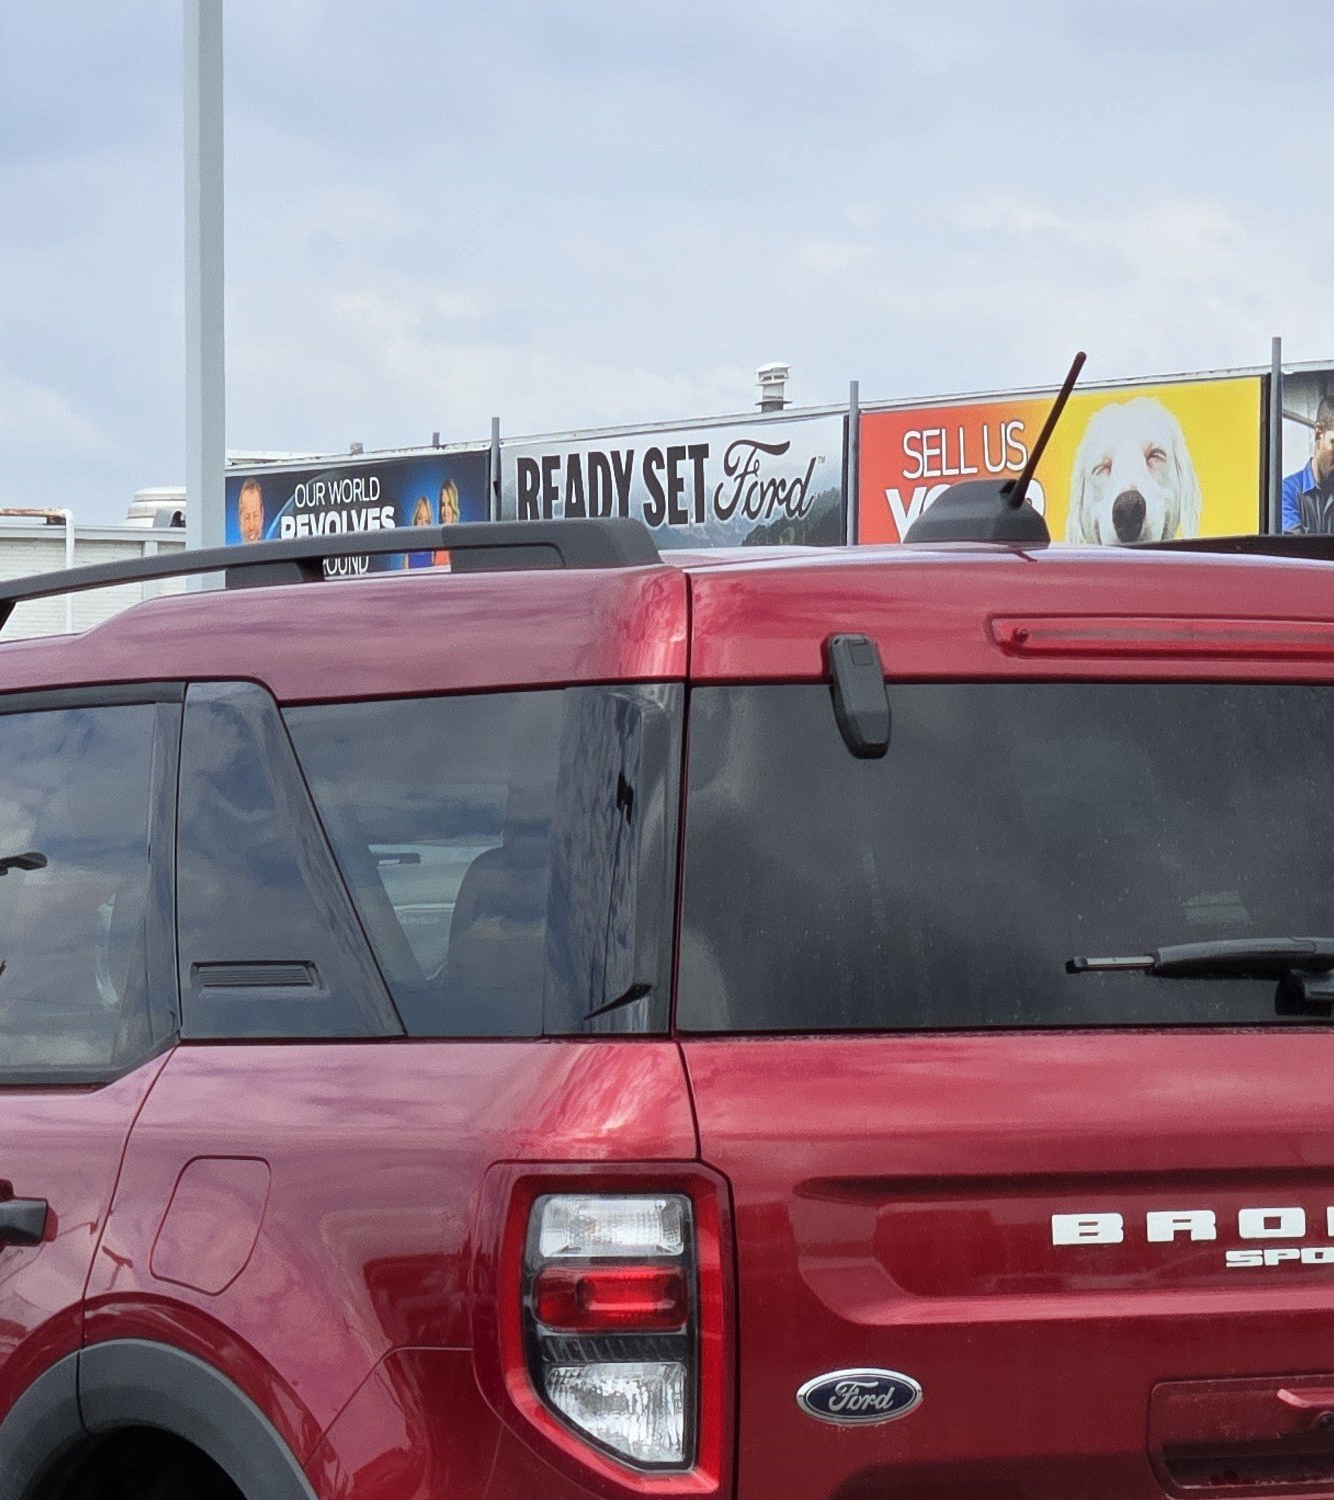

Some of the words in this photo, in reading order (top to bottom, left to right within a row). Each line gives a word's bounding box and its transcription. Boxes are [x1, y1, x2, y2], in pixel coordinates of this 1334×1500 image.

[903, 426, 977, 479] SELL
[983, 421, 1028, 472] US
[295, 482, 325, 508] OUR
[328, 477, 380, 504] WORLD
[517, 449, 634, 521] READY
[642, 443, 709, 528] SET
[714, 439, 817, 521] Ford
[828, 1380, 895, 1412] Ford
